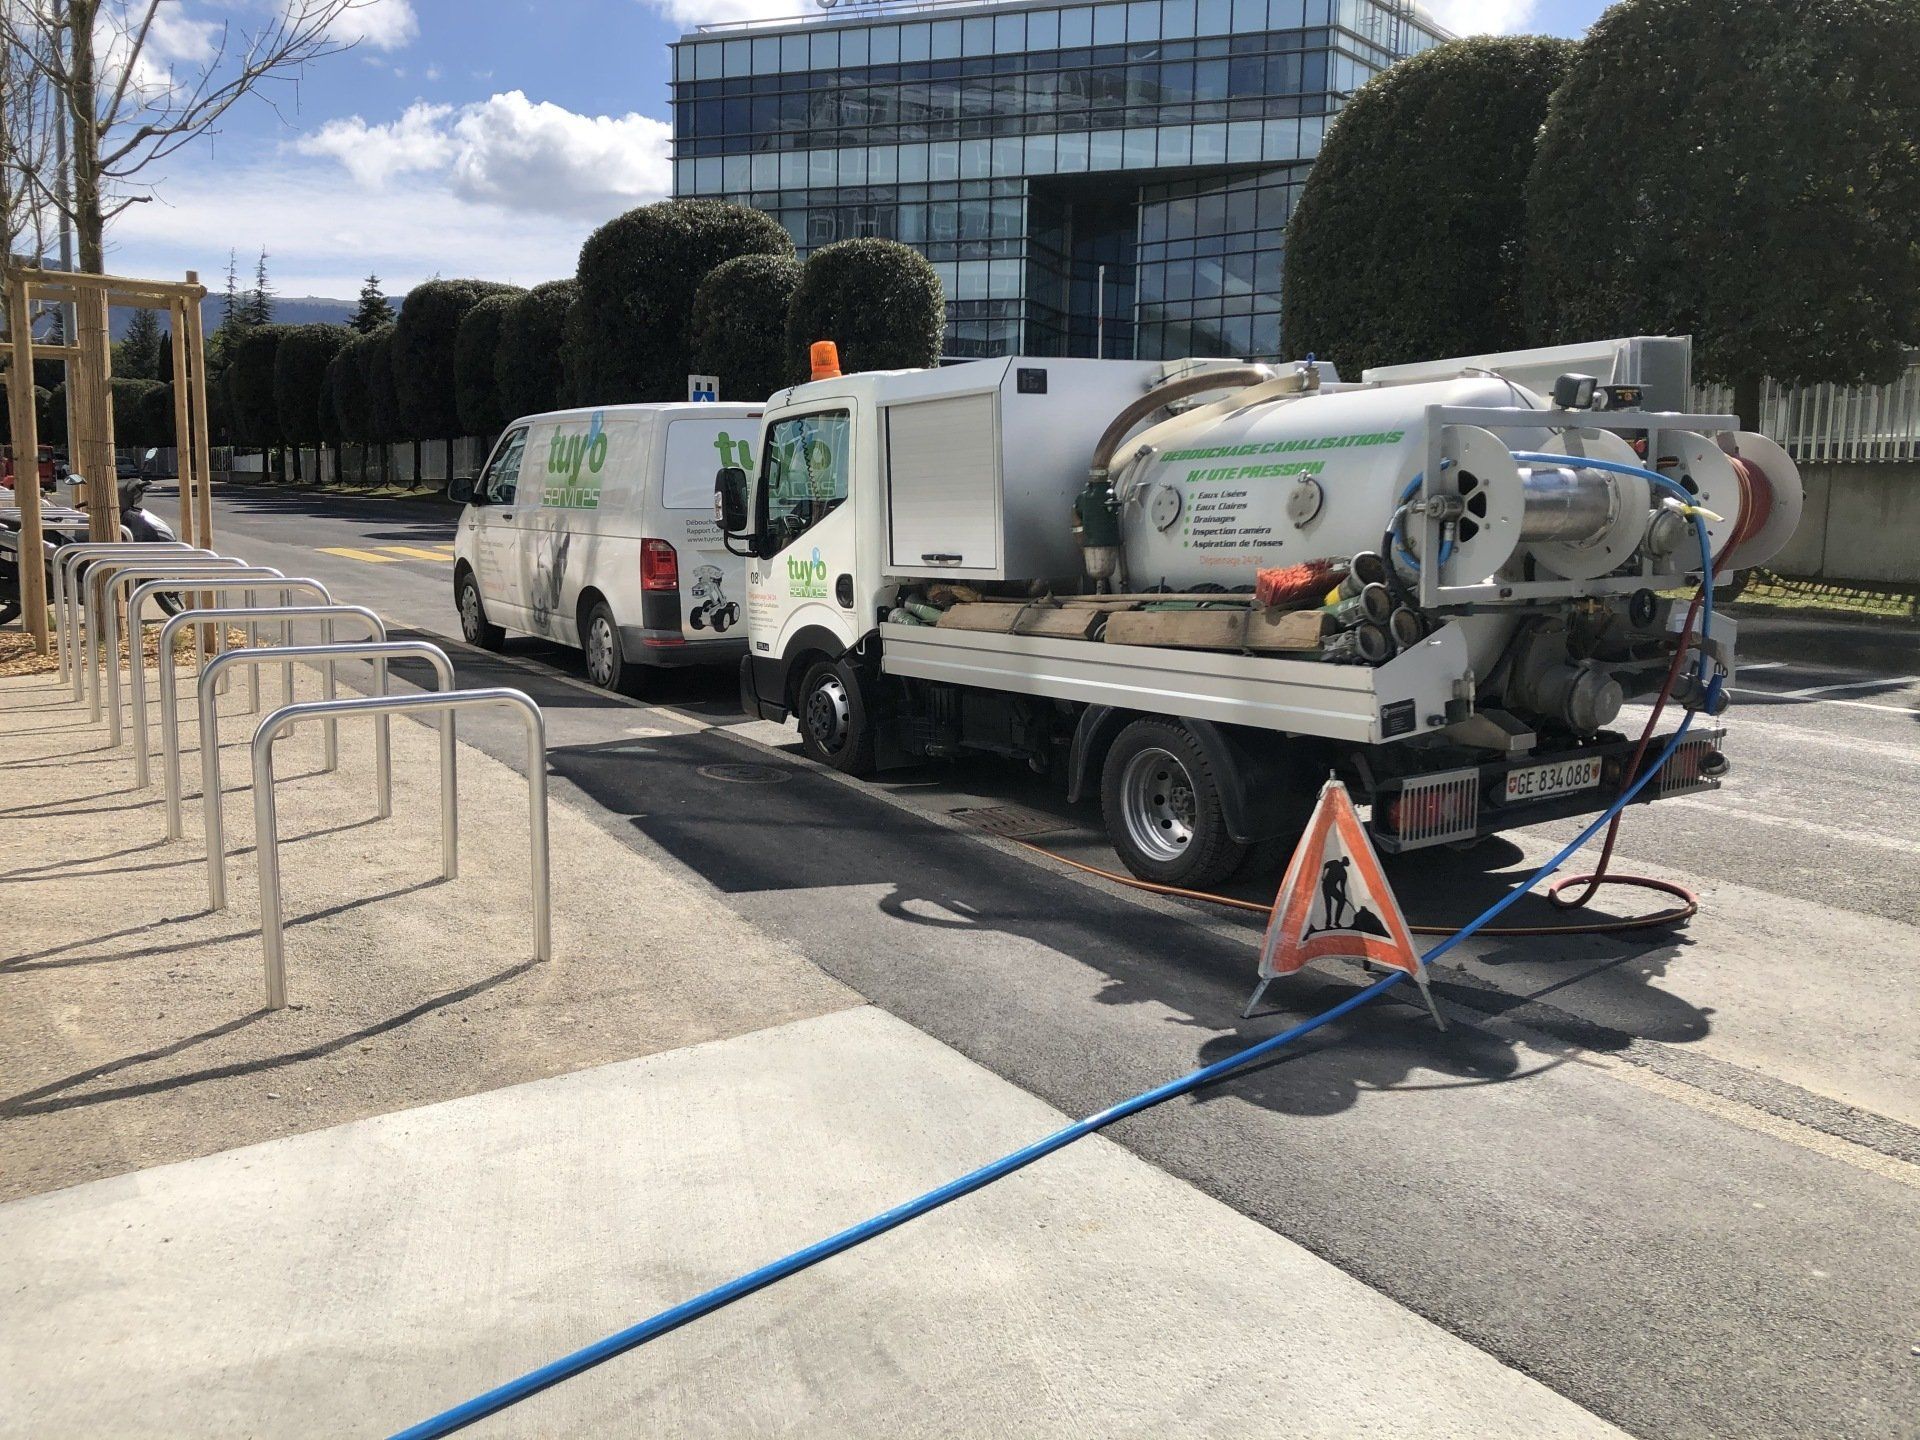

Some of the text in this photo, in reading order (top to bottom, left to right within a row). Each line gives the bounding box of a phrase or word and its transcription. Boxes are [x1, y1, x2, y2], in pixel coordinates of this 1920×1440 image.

[1259, 431, 1406, 454] CANALISATIONS
[548, 424, 608, 487] tuyo
[542, 488, 601, 510] services
[1198, 491, 1219, 500] Eaux
[1195, 502, 1248, 512] Eaux Claires
[1193, 514, 1236, 525] Drainages
[1192, 525, 1272, 537] Inspection caméra
[1192, 538, 1284, 550] Aspiration de fosses
[787, 554, 827, 587] tuyo
